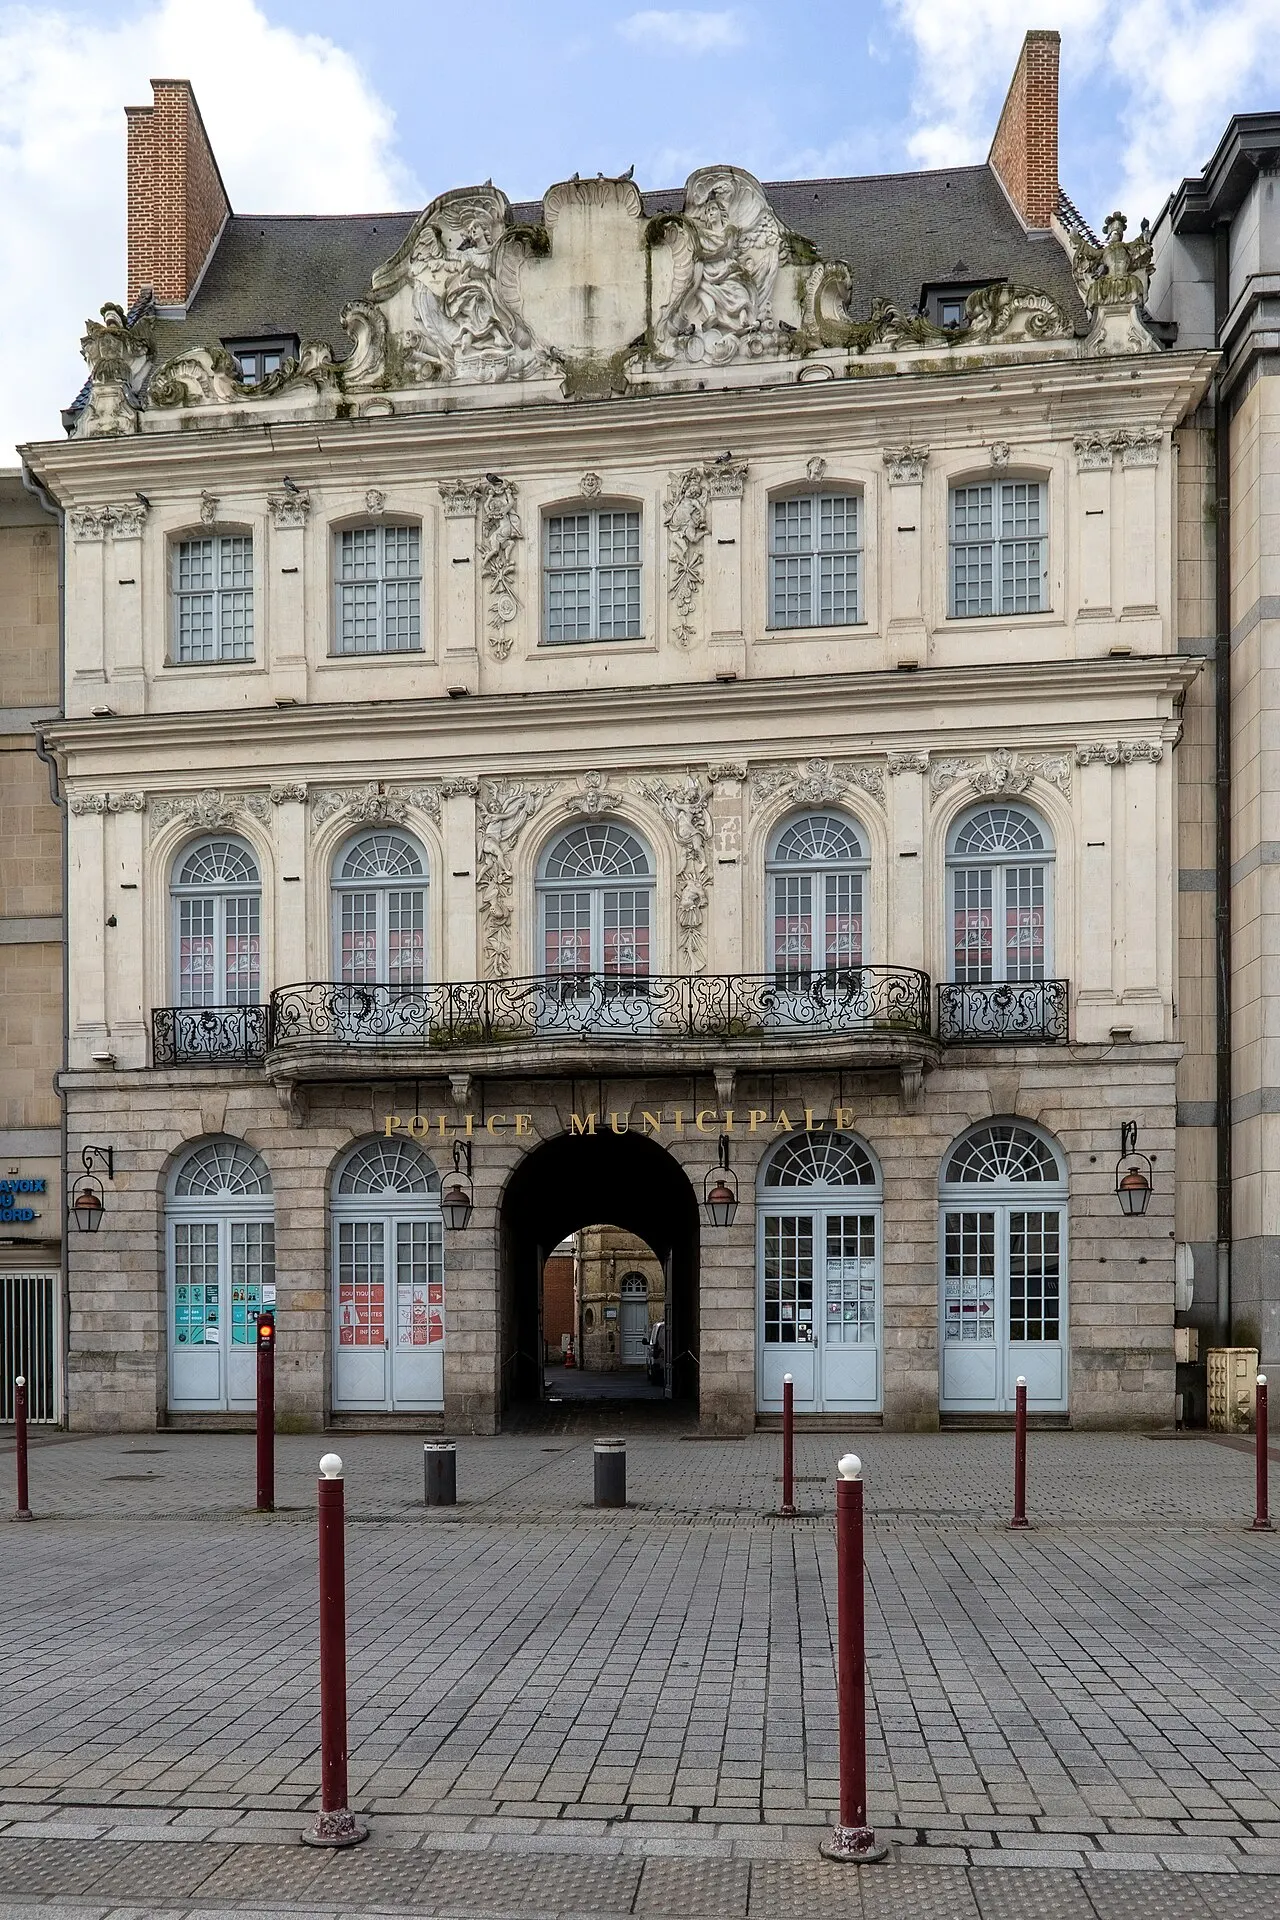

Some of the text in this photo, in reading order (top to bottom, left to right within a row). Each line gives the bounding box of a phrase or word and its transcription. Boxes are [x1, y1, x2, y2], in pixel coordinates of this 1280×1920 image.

[383, 1108, 855, 1138] POLICE MUNICIPALE
[10, 1179, 46, 1192] VOIX
[0, 1194, 14, 1207] U
[0, 1208, 34, 1221] ORD
